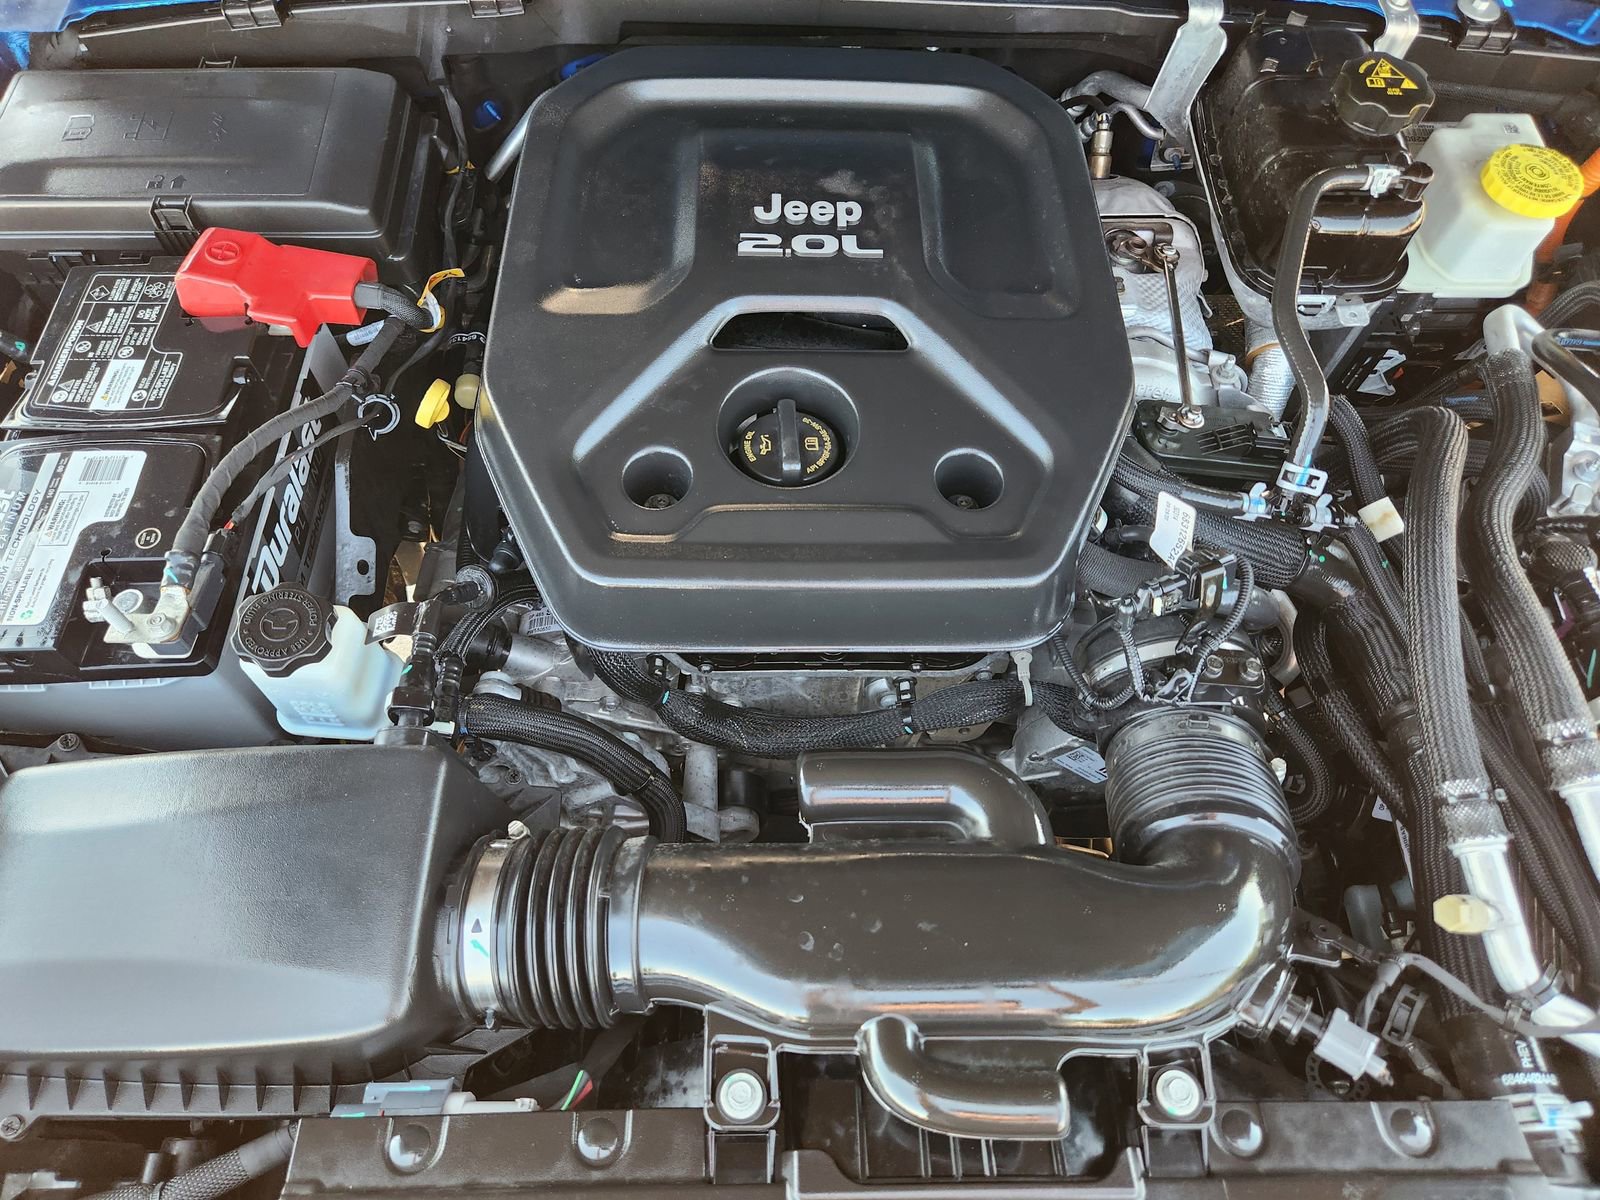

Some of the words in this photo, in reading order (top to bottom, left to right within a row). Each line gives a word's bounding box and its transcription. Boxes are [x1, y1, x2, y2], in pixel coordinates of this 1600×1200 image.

[753, 193, 862, 230] Jeep
[737, 233, 884, 258] 2.0L
[135, 309, 146, 318] DO
[142, 308, 153, 319] NOT
[49, 319, 85, 379] DANGER/POISON
[147, 360, 172, 401] NON-SPILLABLE
[745, 430, 755, 440] OIL
[743, 440, 757, 463] ENGINE
[806, 464, 819, 474] API
[0, 490, 28, 551] LATINUM
[6, 488, 42, 562] TECHNOLOGY
[49, 499, 66, 530] WARNING:
[7, 568, 35, 621] NON-SPILLABLE
[261, 591, 304, 604] STEERING
[243, 603, 261, 625] FLUID
[302, 599, 318, 626] POWER
[245, 637, 288, 657] APPROVED
[291, 638, 308, 651] USE
[1515, 1039, 1534, 1068] PHEV
